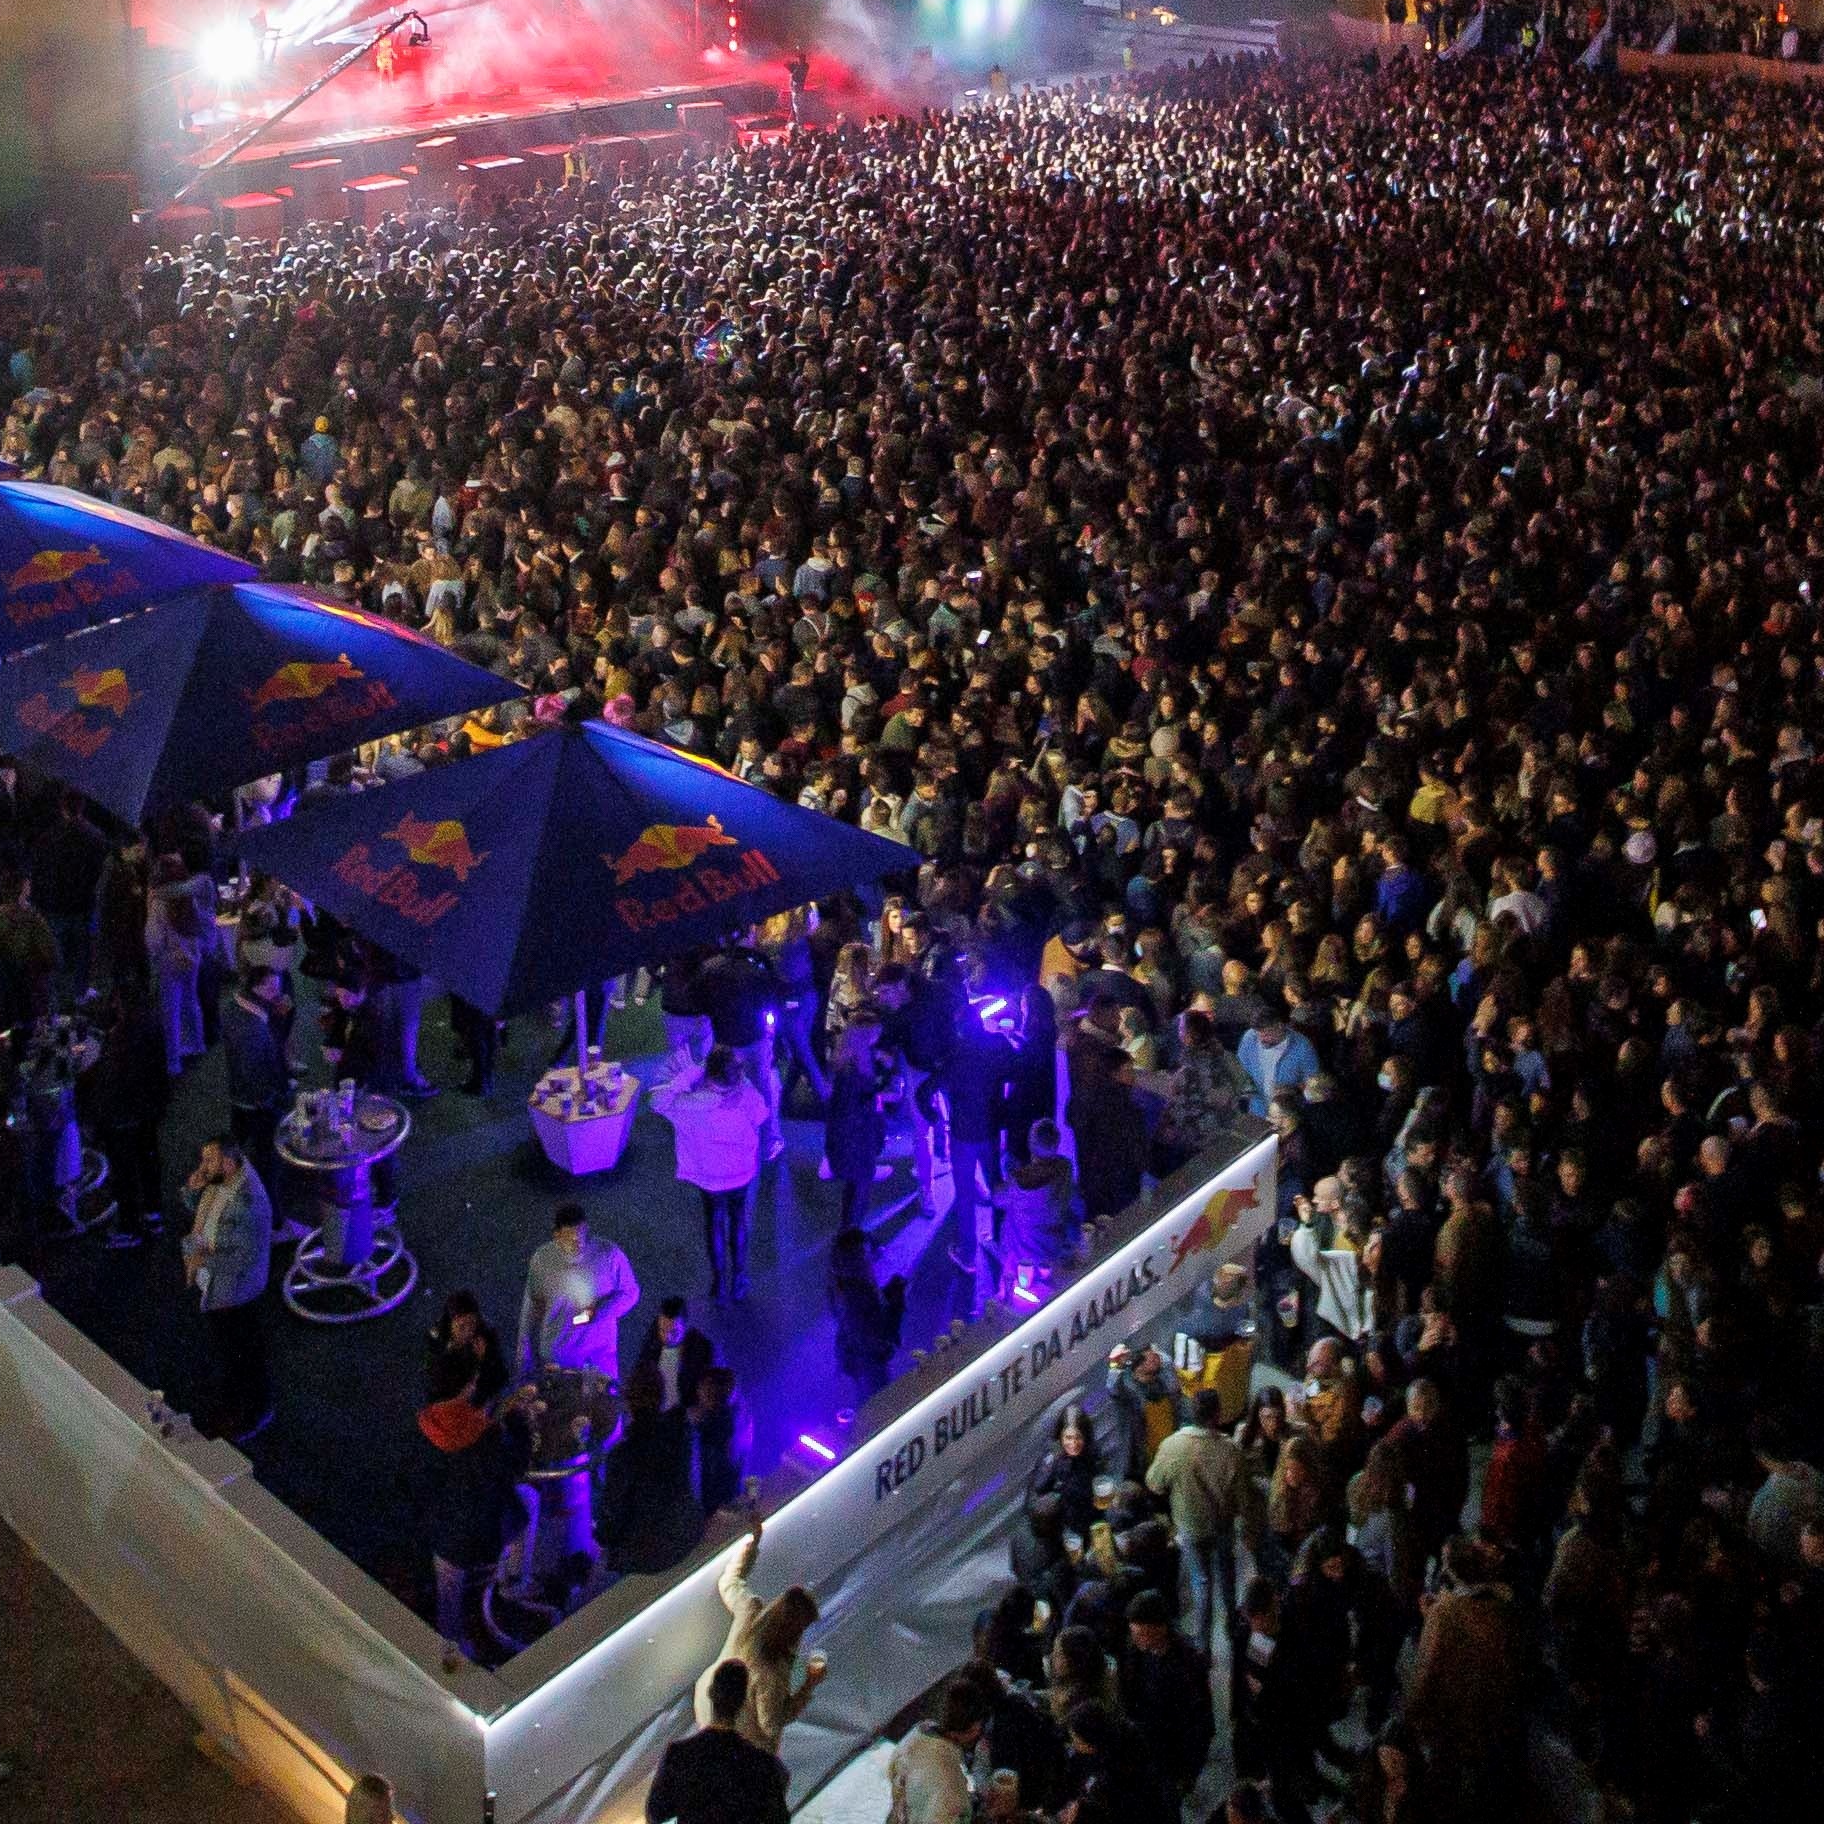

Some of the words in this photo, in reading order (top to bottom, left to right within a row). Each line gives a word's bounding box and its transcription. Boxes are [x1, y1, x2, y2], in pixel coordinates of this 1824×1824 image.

[615, 878, 706, 933] Red
[696, 849, 781, 903] Bull
[876, 1434, 925, 1501] RED
[933, 1382, 992, 1456] BULL
[999, 1355, 1026, 1402] TE
[1031, 1327, 1064, 1378] DA
